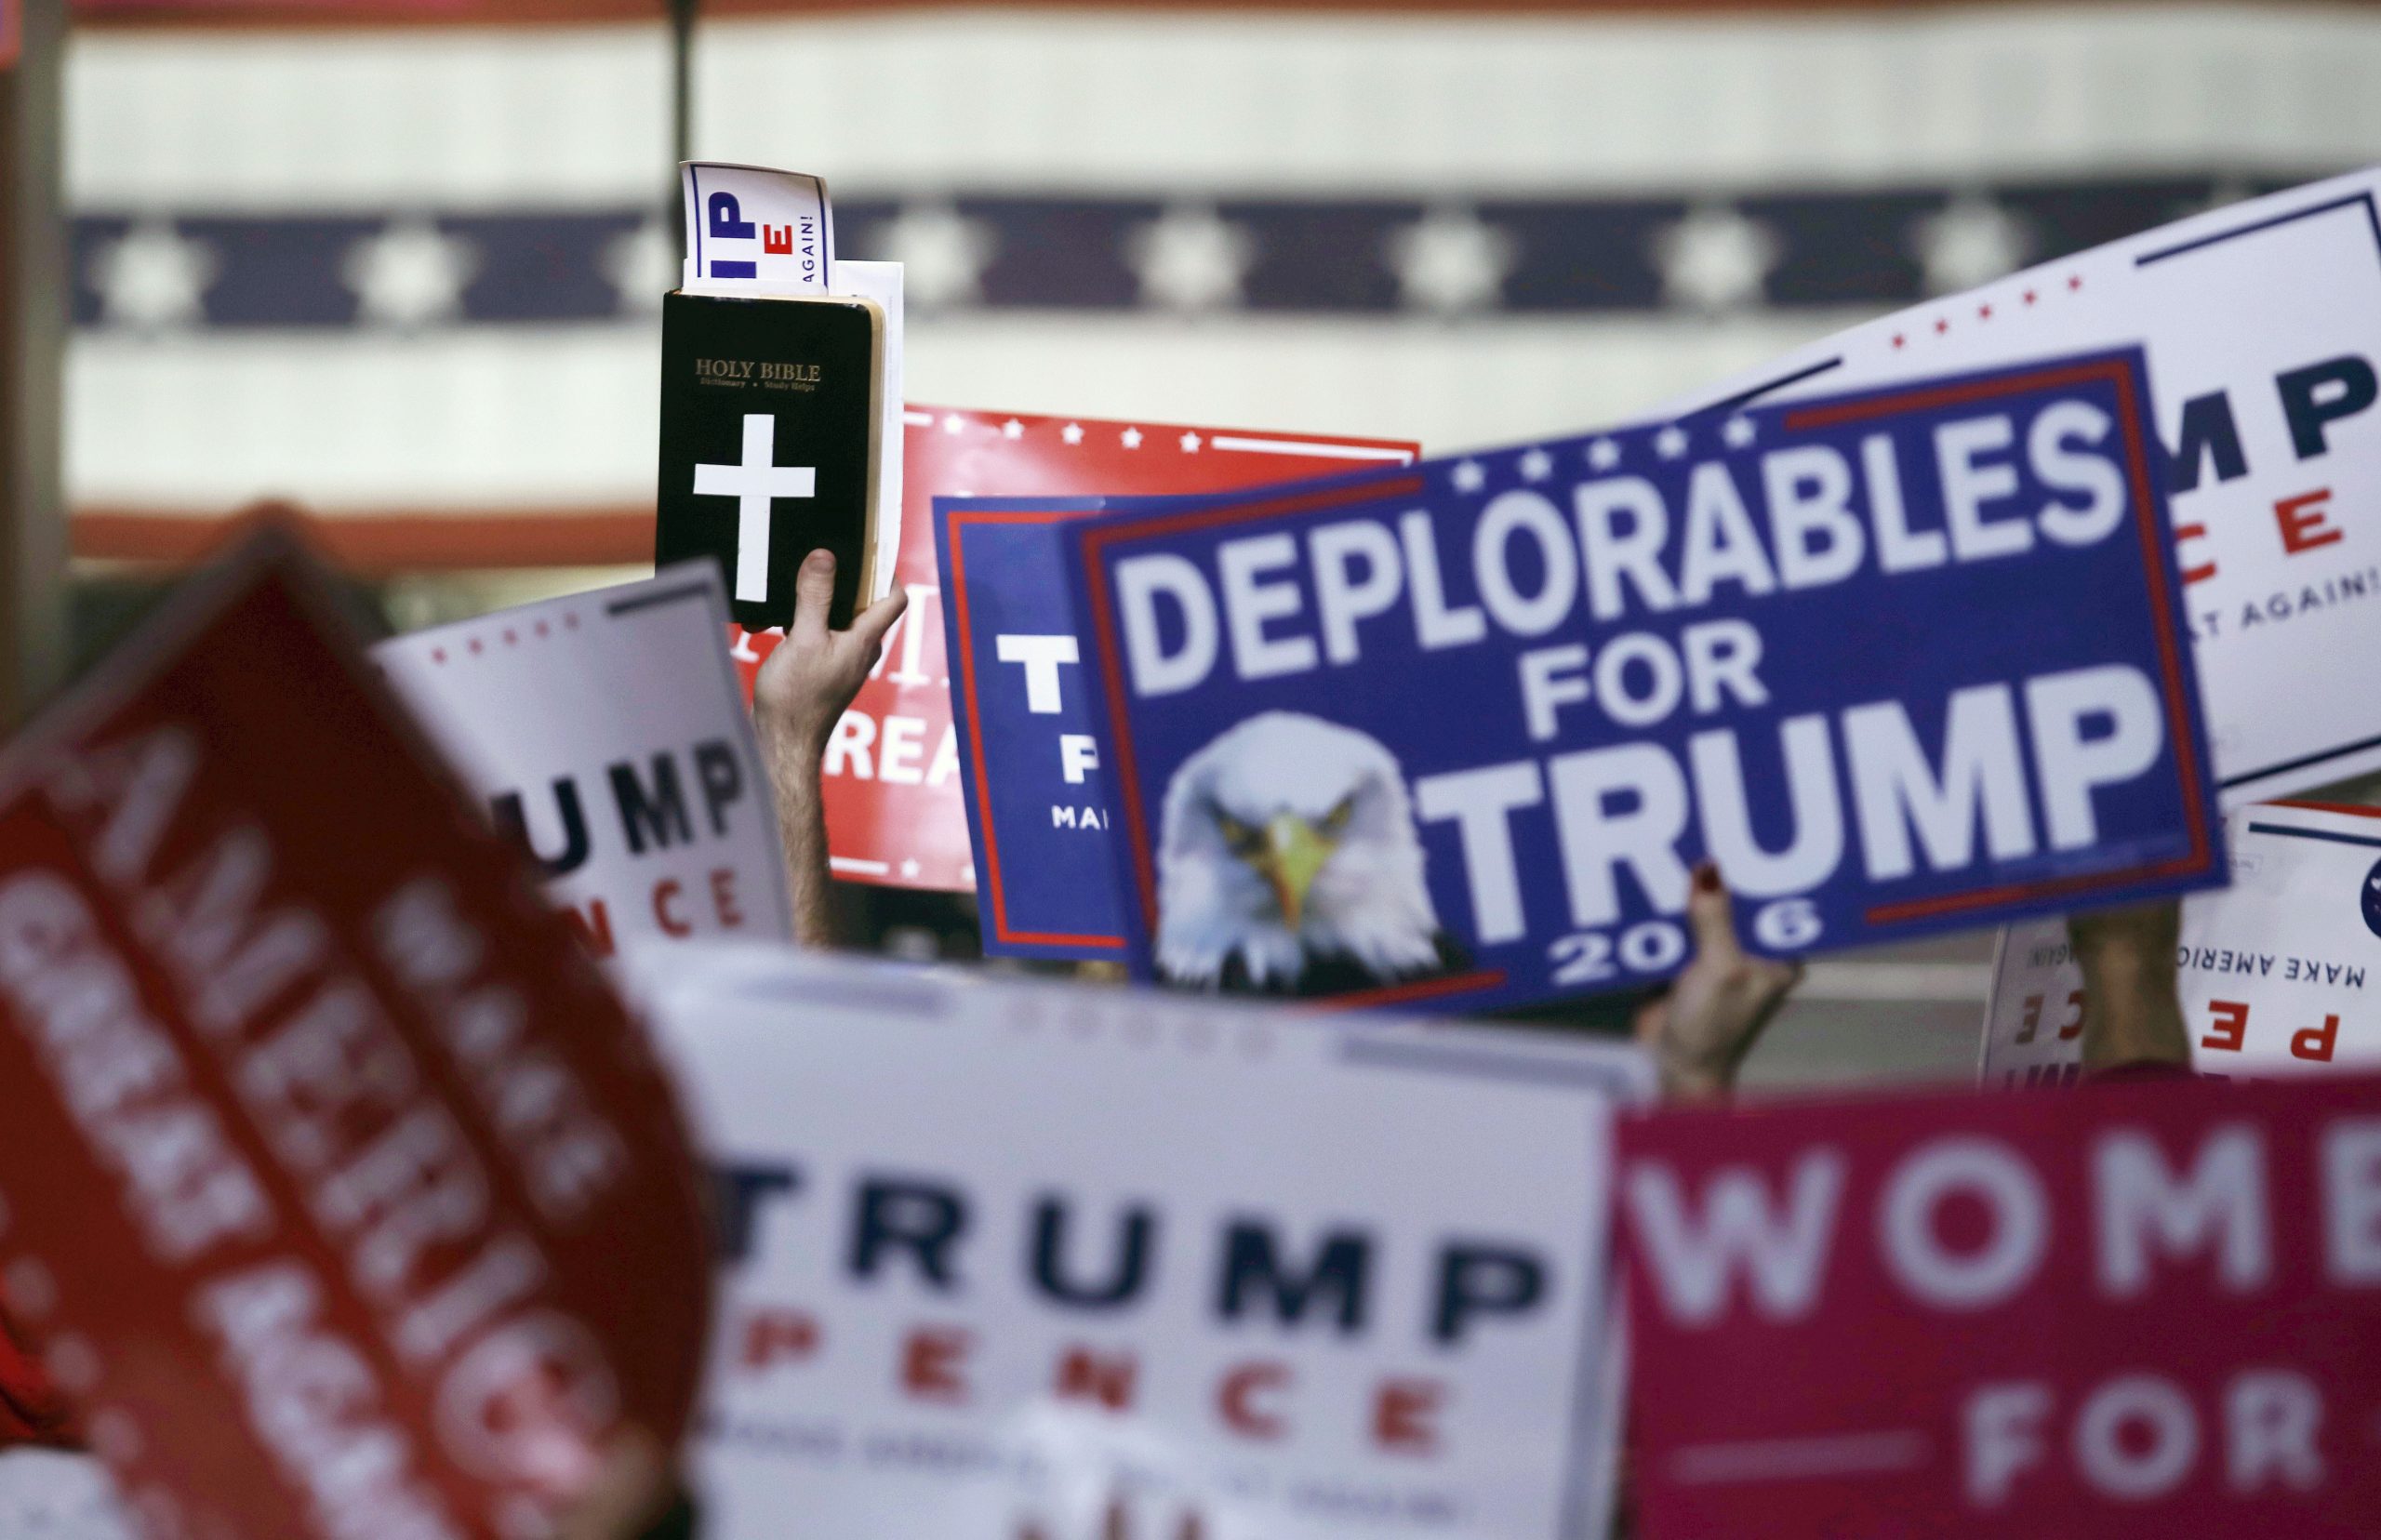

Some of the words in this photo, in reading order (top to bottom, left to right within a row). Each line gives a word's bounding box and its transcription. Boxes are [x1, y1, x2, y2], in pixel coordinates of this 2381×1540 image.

[800, 215, 815, 283] AGAIN!
[695, 358, 755, 378] HOLY
[760, 362, 821, 382] BIBLE
[699, 377, 746, 388] Dictionary
[764, 380, 789, 391] Study
[791, 381, 816, 392] Helps
[1115, 398, 2130, 700] DEPLORABLES
[2240, 565, 2381, 631] AGAIN!
[1517, 617, 1770, 743] FOR
[1050, 804, 1110, 831] MA
[1414, 661, 2166, 945] TRUMP
[1546, 897, 1823, 987] 206
[2284, 959, 2365, 989] MAKE
[45, 719, 623, 1540] AMERIC
[718, 1159, 1553, 1345] TRUMP
[737, 1308, 1447, 1456] PENCE
[1959, 1369, 2330, 1508] FOR
